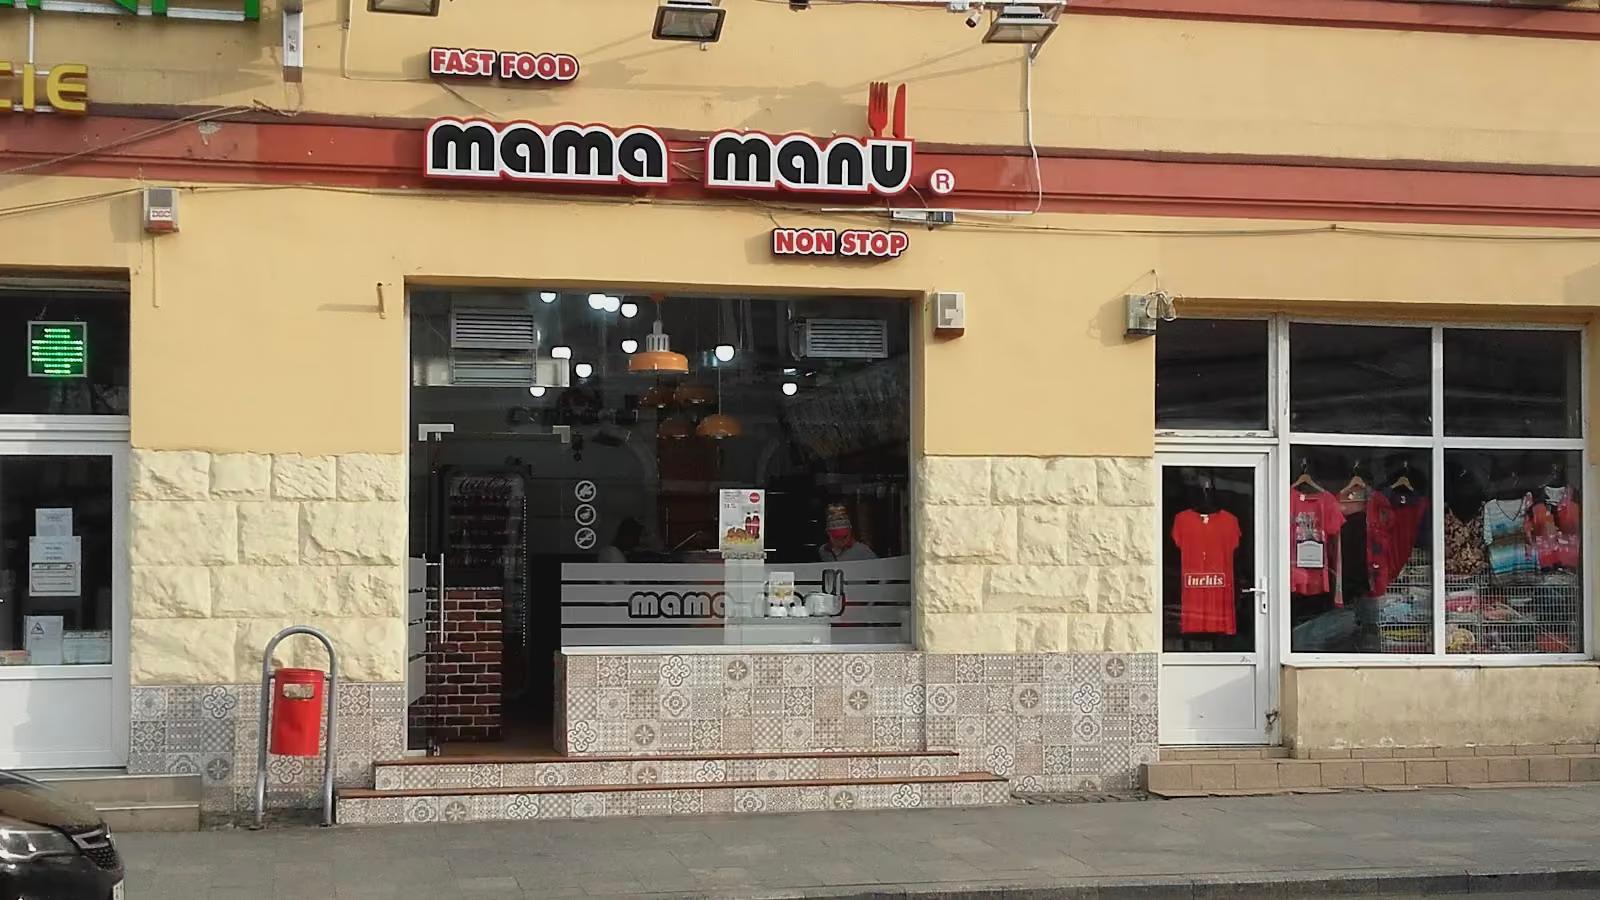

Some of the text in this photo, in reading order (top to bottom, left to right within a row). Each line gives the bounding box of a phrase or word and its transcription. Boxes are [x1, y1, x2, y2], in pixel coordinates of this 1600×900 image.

[432, 50, 577, 79] FAST FOOD
[430, 122, 665, 179] mama
[712, 135, 909, 189] manu
[775, 231, 906, 255] NON STOP
